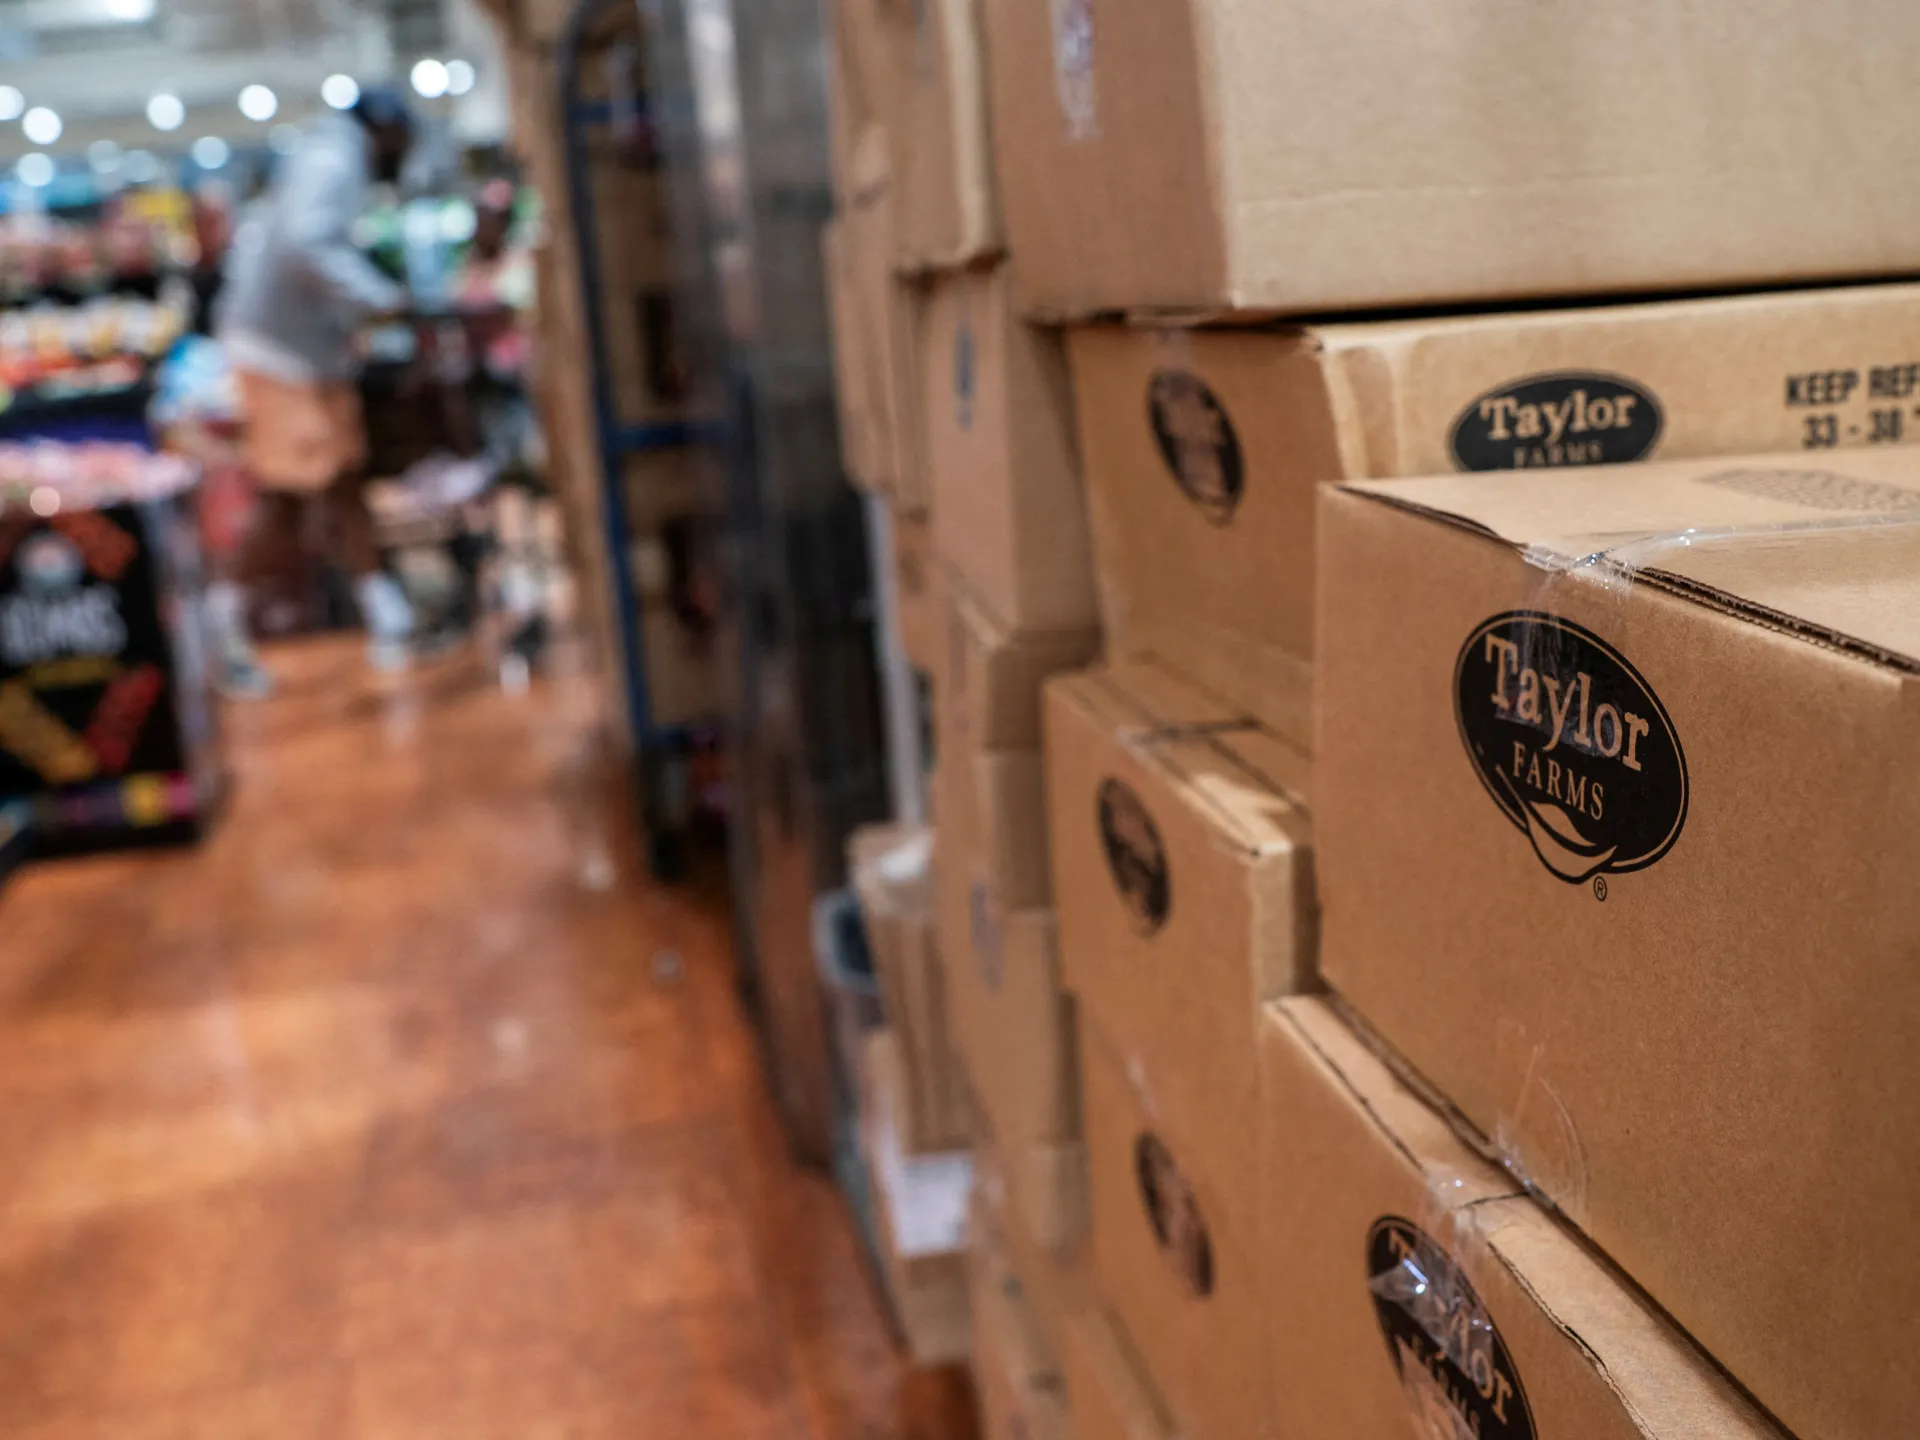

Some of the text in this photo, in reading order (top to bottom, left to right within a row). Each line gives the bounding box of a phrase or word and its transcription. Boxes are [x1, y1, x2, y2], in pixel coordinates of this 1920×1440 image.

[1479, 389, 1637, 442] Taylor
[1785, 368, 1858, 406] KEEP
[1485, 632, 1649, 771] Taylor
[1512, 741, 1604, 820] FARMS
[1388, 1227, 1513, 1426] Tlor
